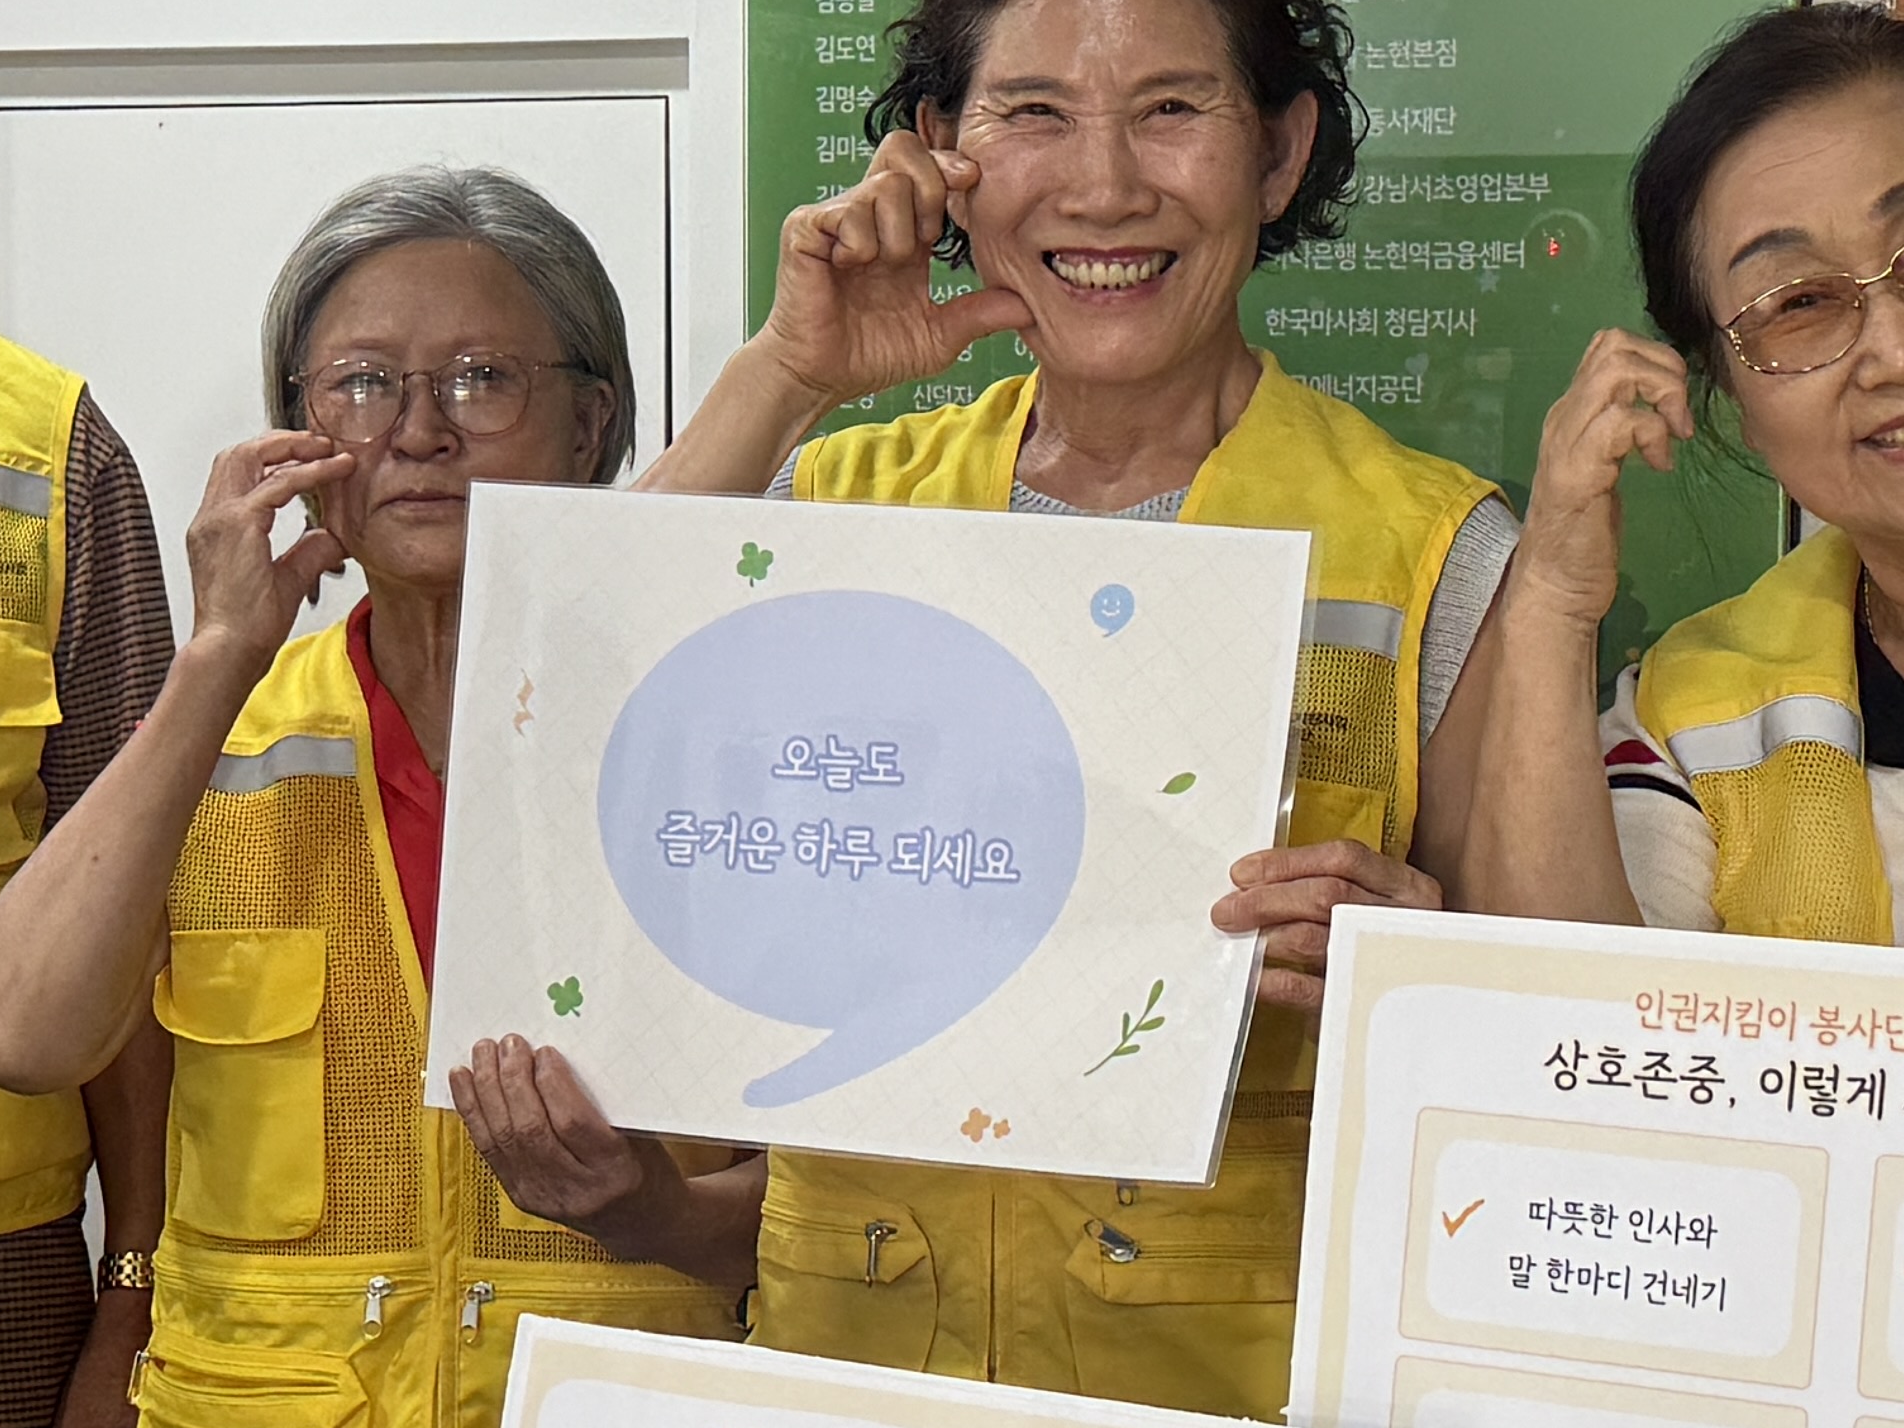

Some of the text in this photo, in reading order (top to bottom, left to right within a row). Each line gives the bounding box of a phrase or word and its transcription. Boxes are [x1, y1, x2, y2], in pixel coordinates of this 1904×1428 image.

[1265, 309, 1477, 336] 한국마사회 청담지사
[775, 735, 904, 790] 오늘도
[659, 812, 1021, 888] 즐거운 하루 되세요
[1636, 990, 1796, 1041] 인권지킴이
[1545, 1040, 1735, 1108] 상호존중,
[1760, 1061, 1886, 1120] 이렇게
[1529, 1198, 1717, 1249] 따뜻한 인사와
[1510, 1255, 1725, 1311] 말 한마디 건네기
